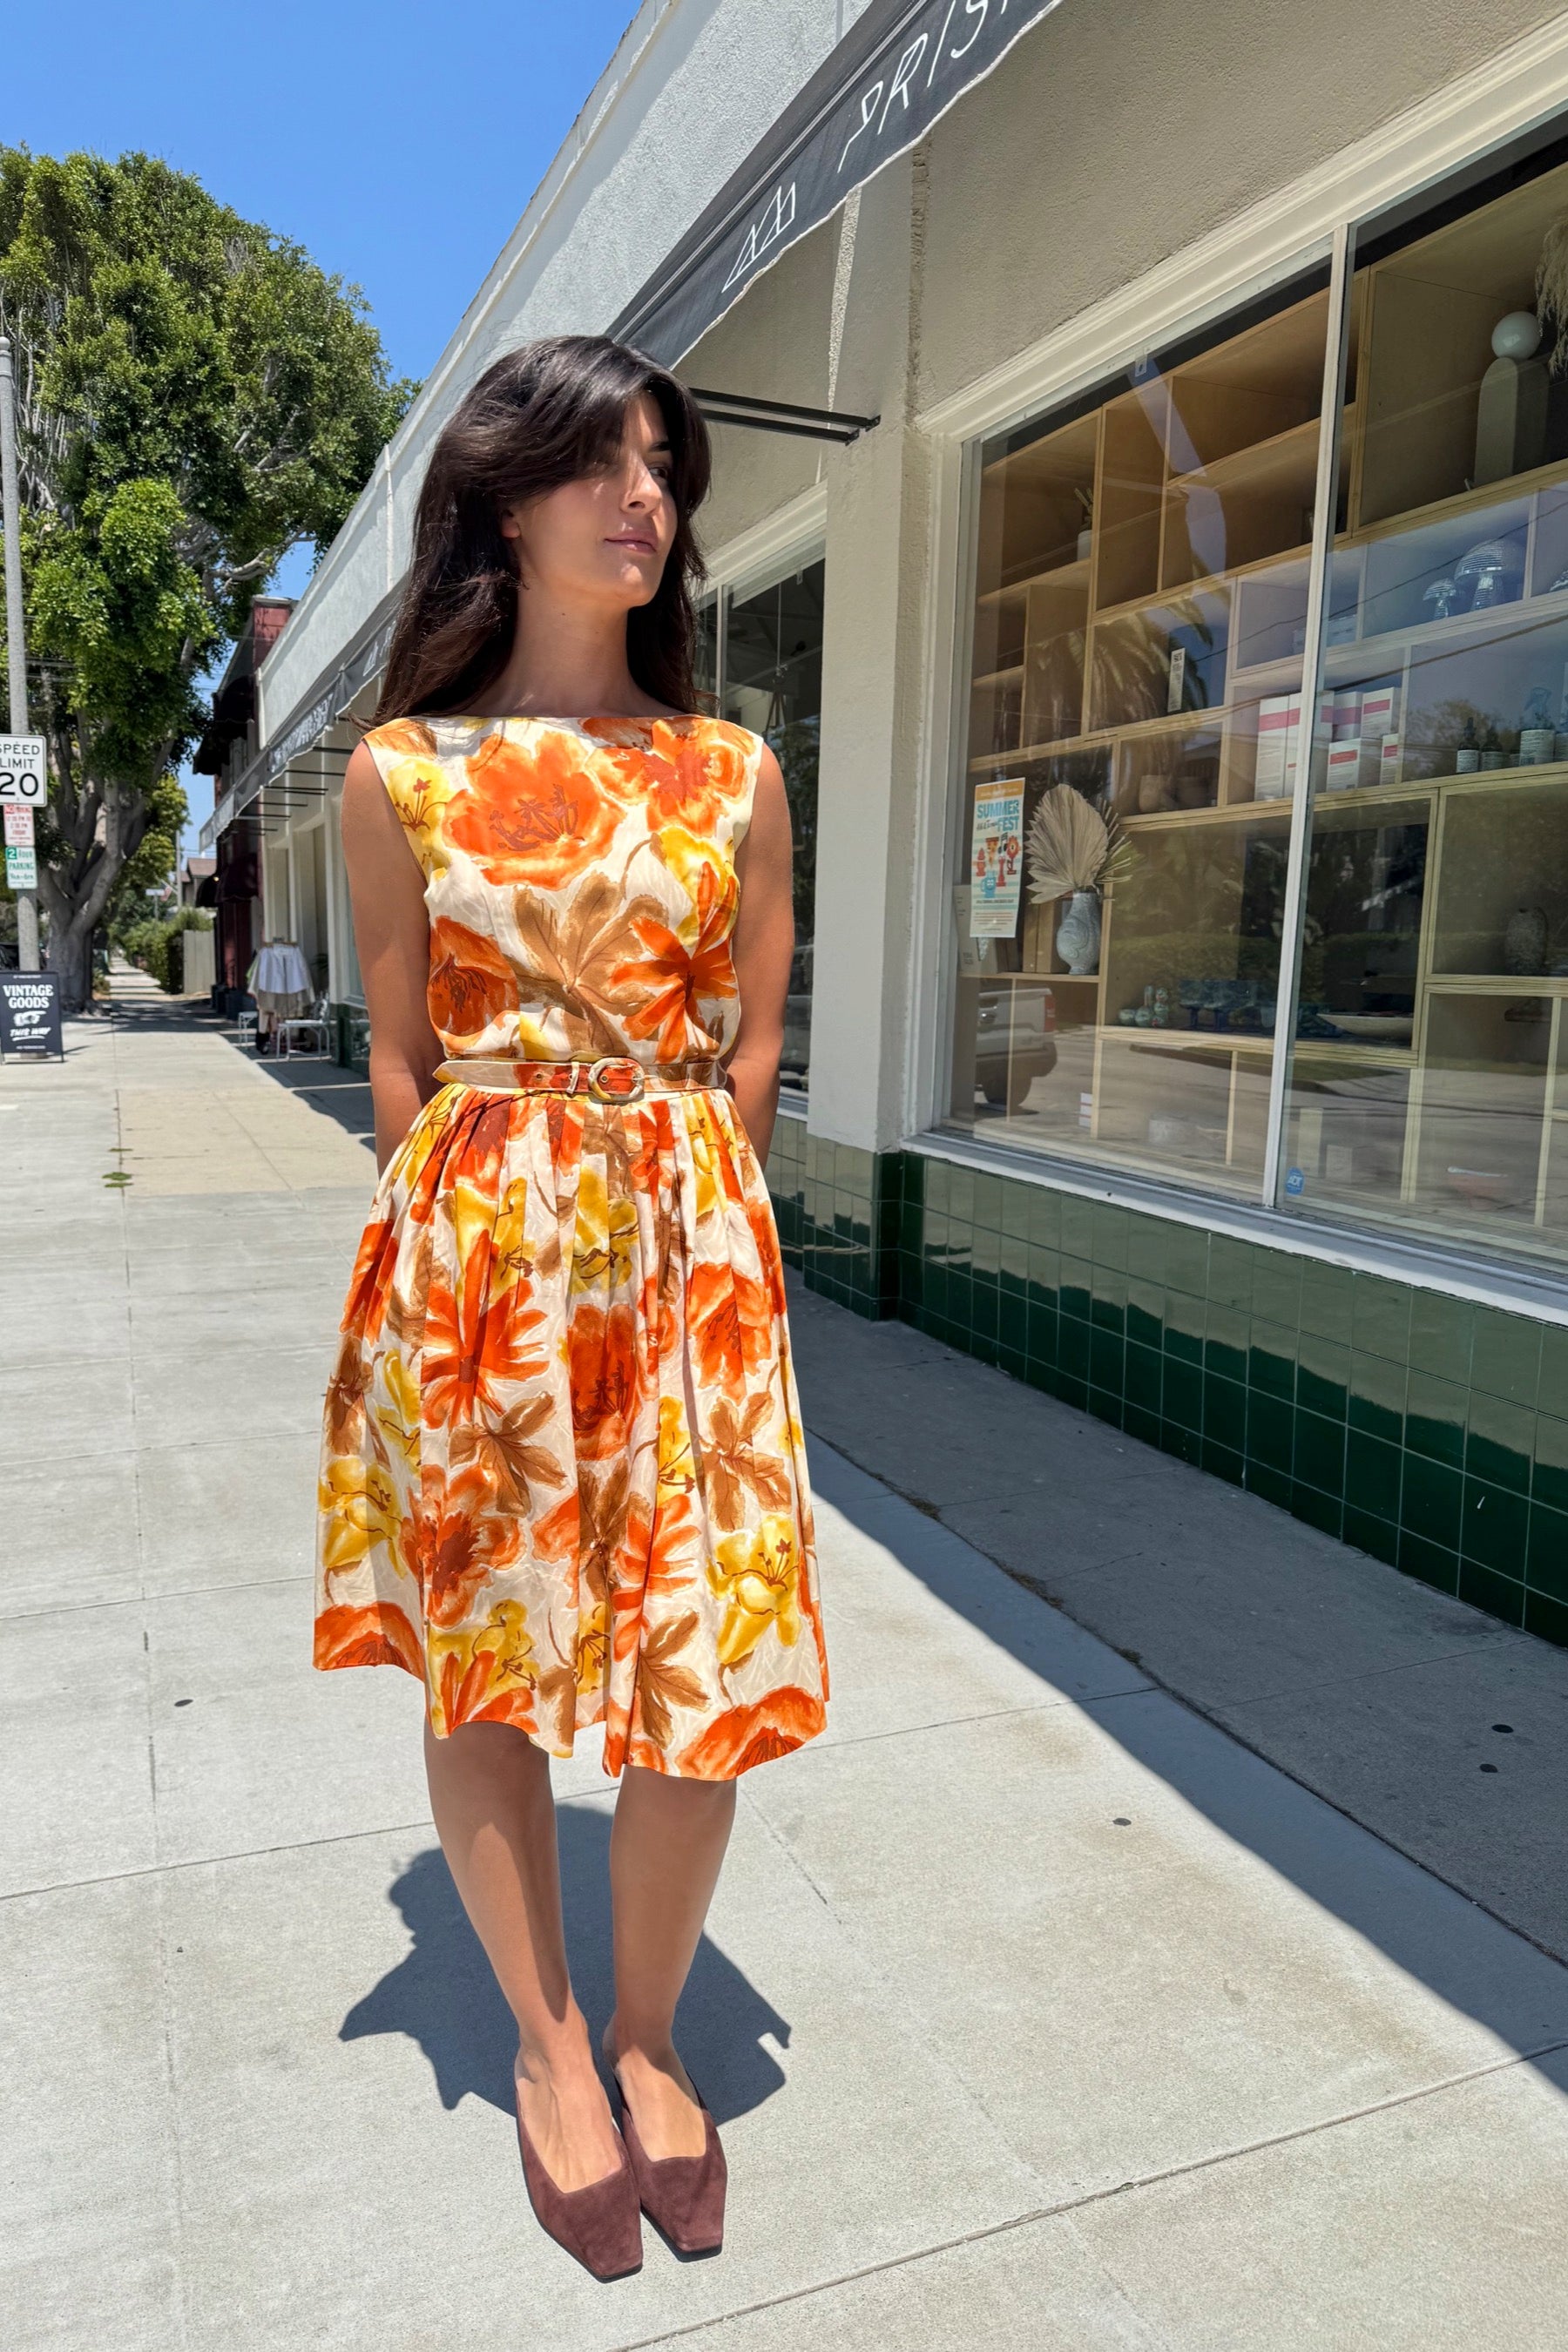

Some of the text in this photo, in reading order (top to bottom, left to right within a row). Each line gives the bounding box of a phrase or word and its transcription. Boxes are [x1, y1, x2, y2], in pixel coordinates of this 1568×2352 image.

[0, 743, 40, 755] PEED
[0, 772, 38, 796] 20
[977, 800, 1019, 818] SUMMER
[997, 815, 1019, 831] FEST
[9, 849, 16, 858] 2
[2, 984, 54, 997] VINTAGE
[8, 997, 50, 1009] GOODS
